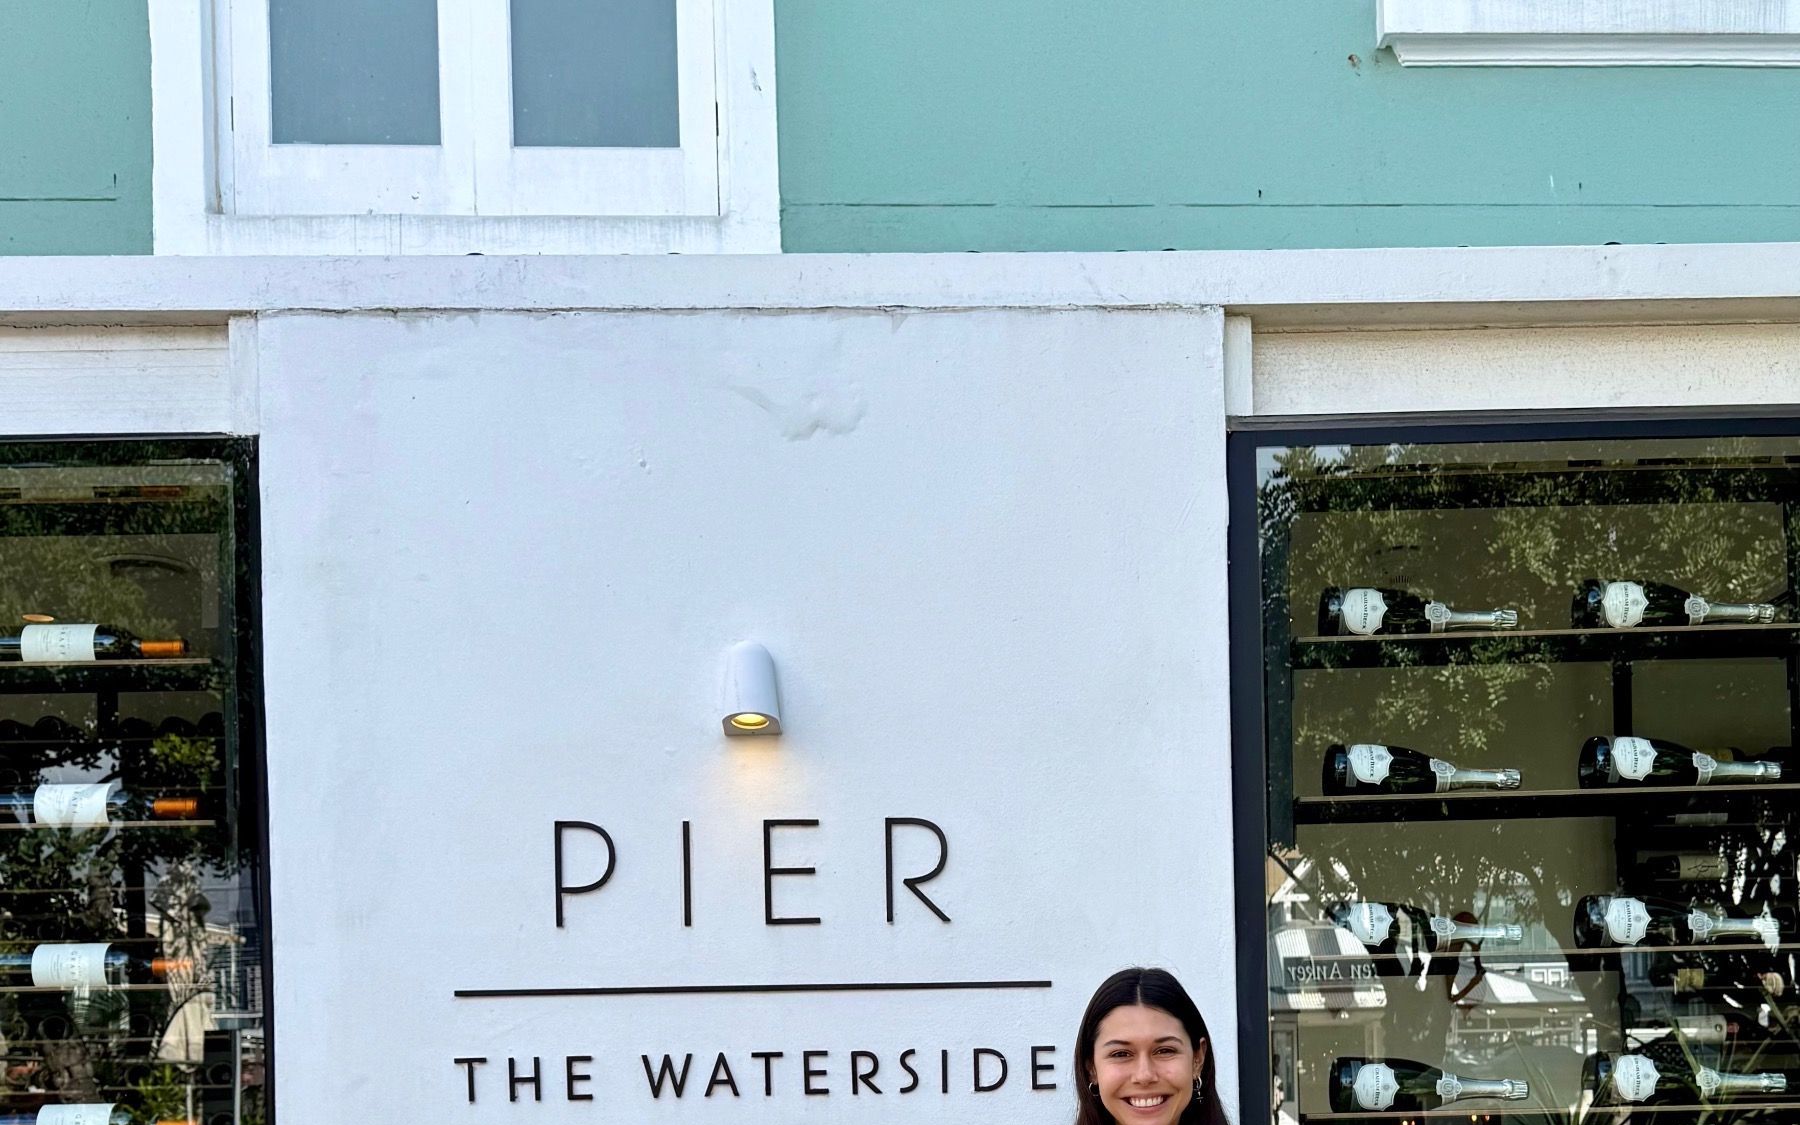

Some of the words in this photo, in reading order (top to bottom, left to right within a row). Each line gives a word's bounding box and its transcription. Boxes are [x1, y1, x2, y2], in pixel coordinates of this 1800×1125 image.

[554, 817, 952, 928] PIER
[454, 1055, 594, 1102] THE
[641, 1046, 1057, 1099] WATERSIDE
